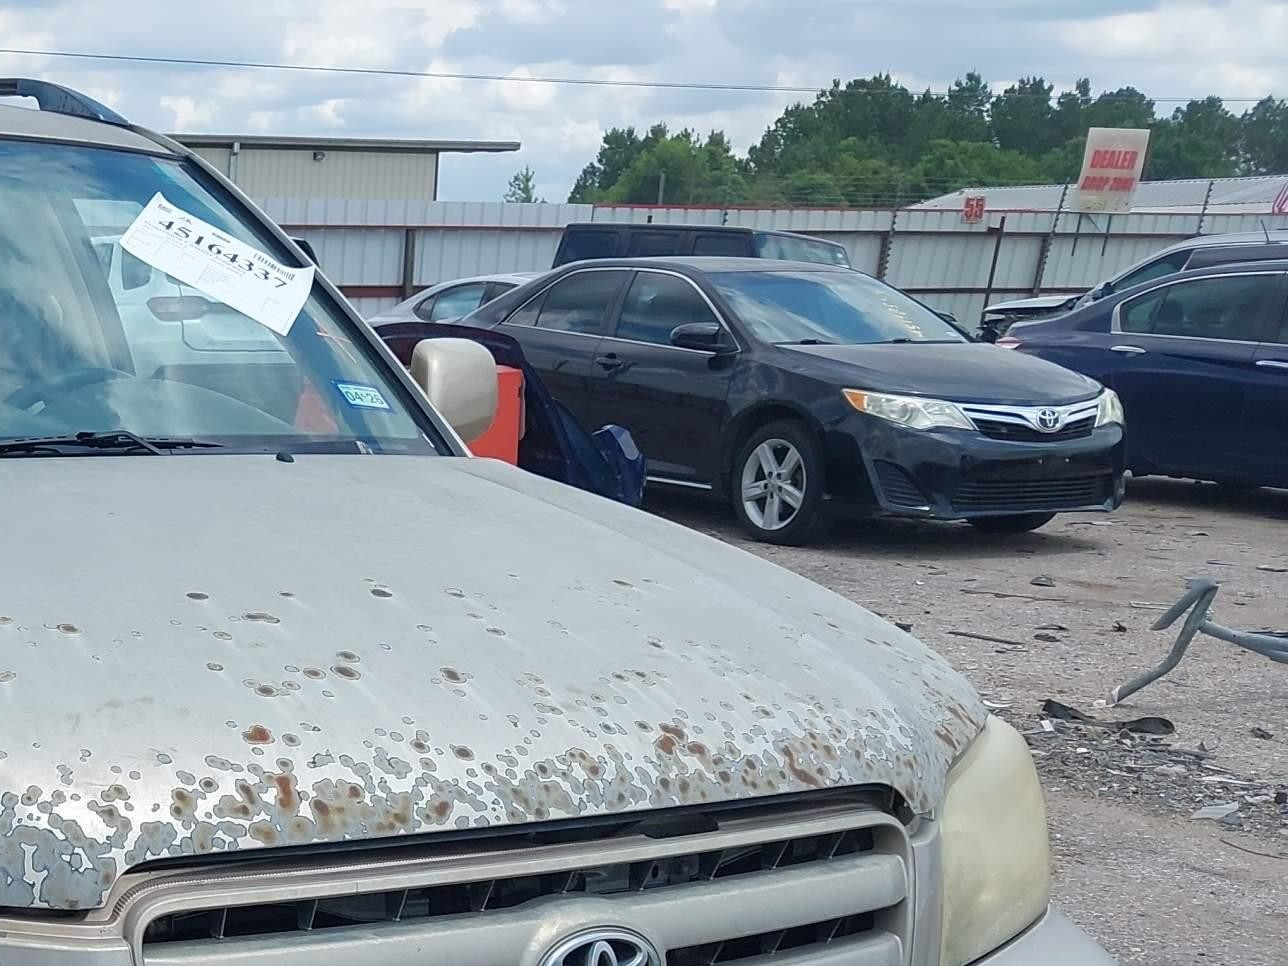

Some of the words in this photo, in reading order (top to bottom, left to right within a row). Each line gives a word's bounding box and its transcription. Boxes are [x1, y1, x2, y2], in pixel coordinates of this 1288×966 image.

[1090, 150, 1139, 169] DEALER
[1080, 176, 1110, 191] DROP
[964, 196, 985, 219] 55
[157, 219, 288, 289] 45164337
